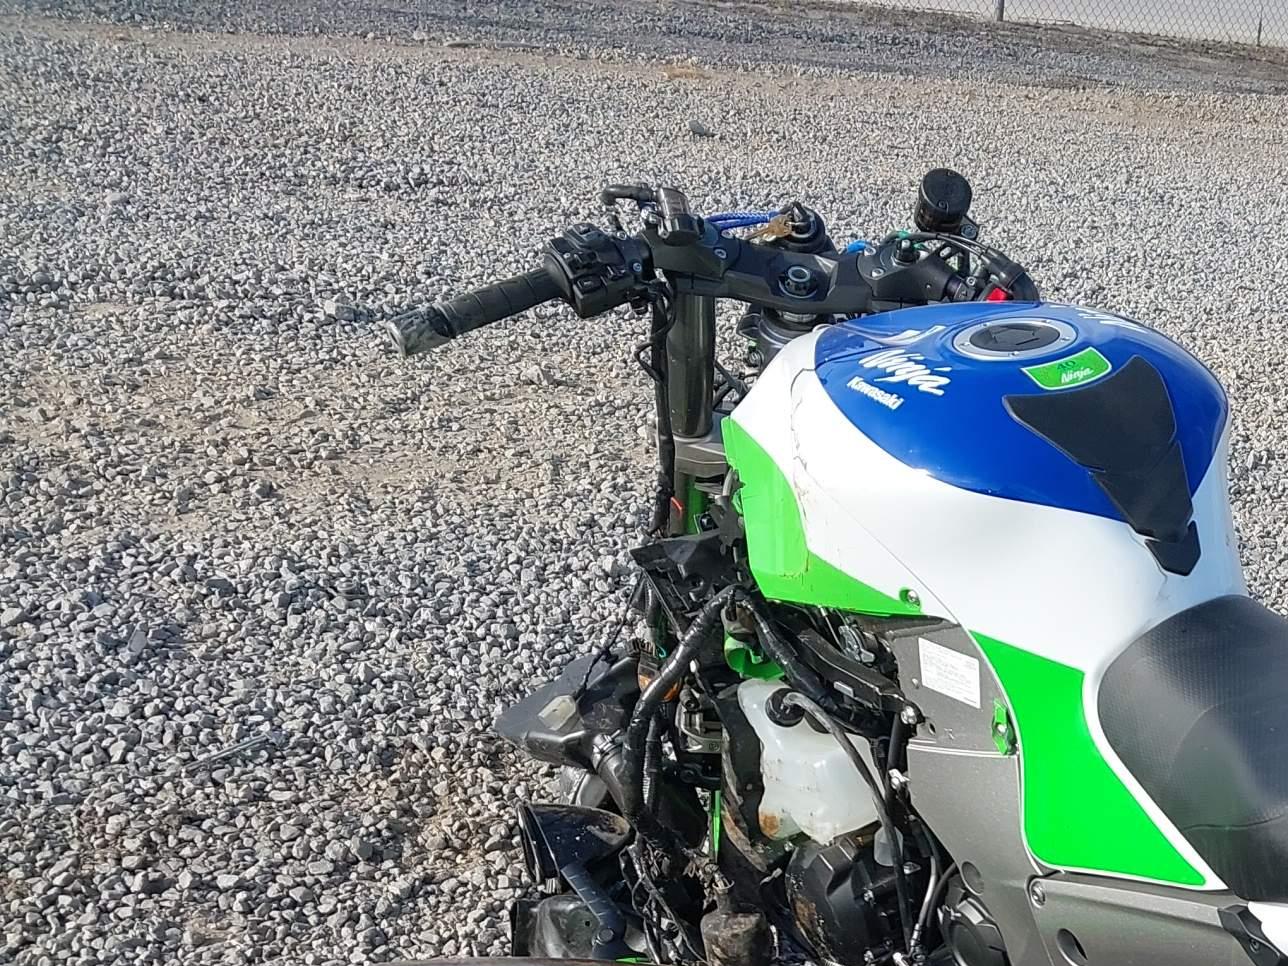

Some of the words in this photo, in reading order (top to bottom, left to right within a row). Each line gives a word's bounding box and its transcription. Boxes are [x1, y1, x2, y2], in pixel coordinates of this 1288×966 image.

[858, 349, 952, 396] Ninja
[1061, 366, 1095, 385] Ninja
[846, 375, 904, 410] Kawasaki
